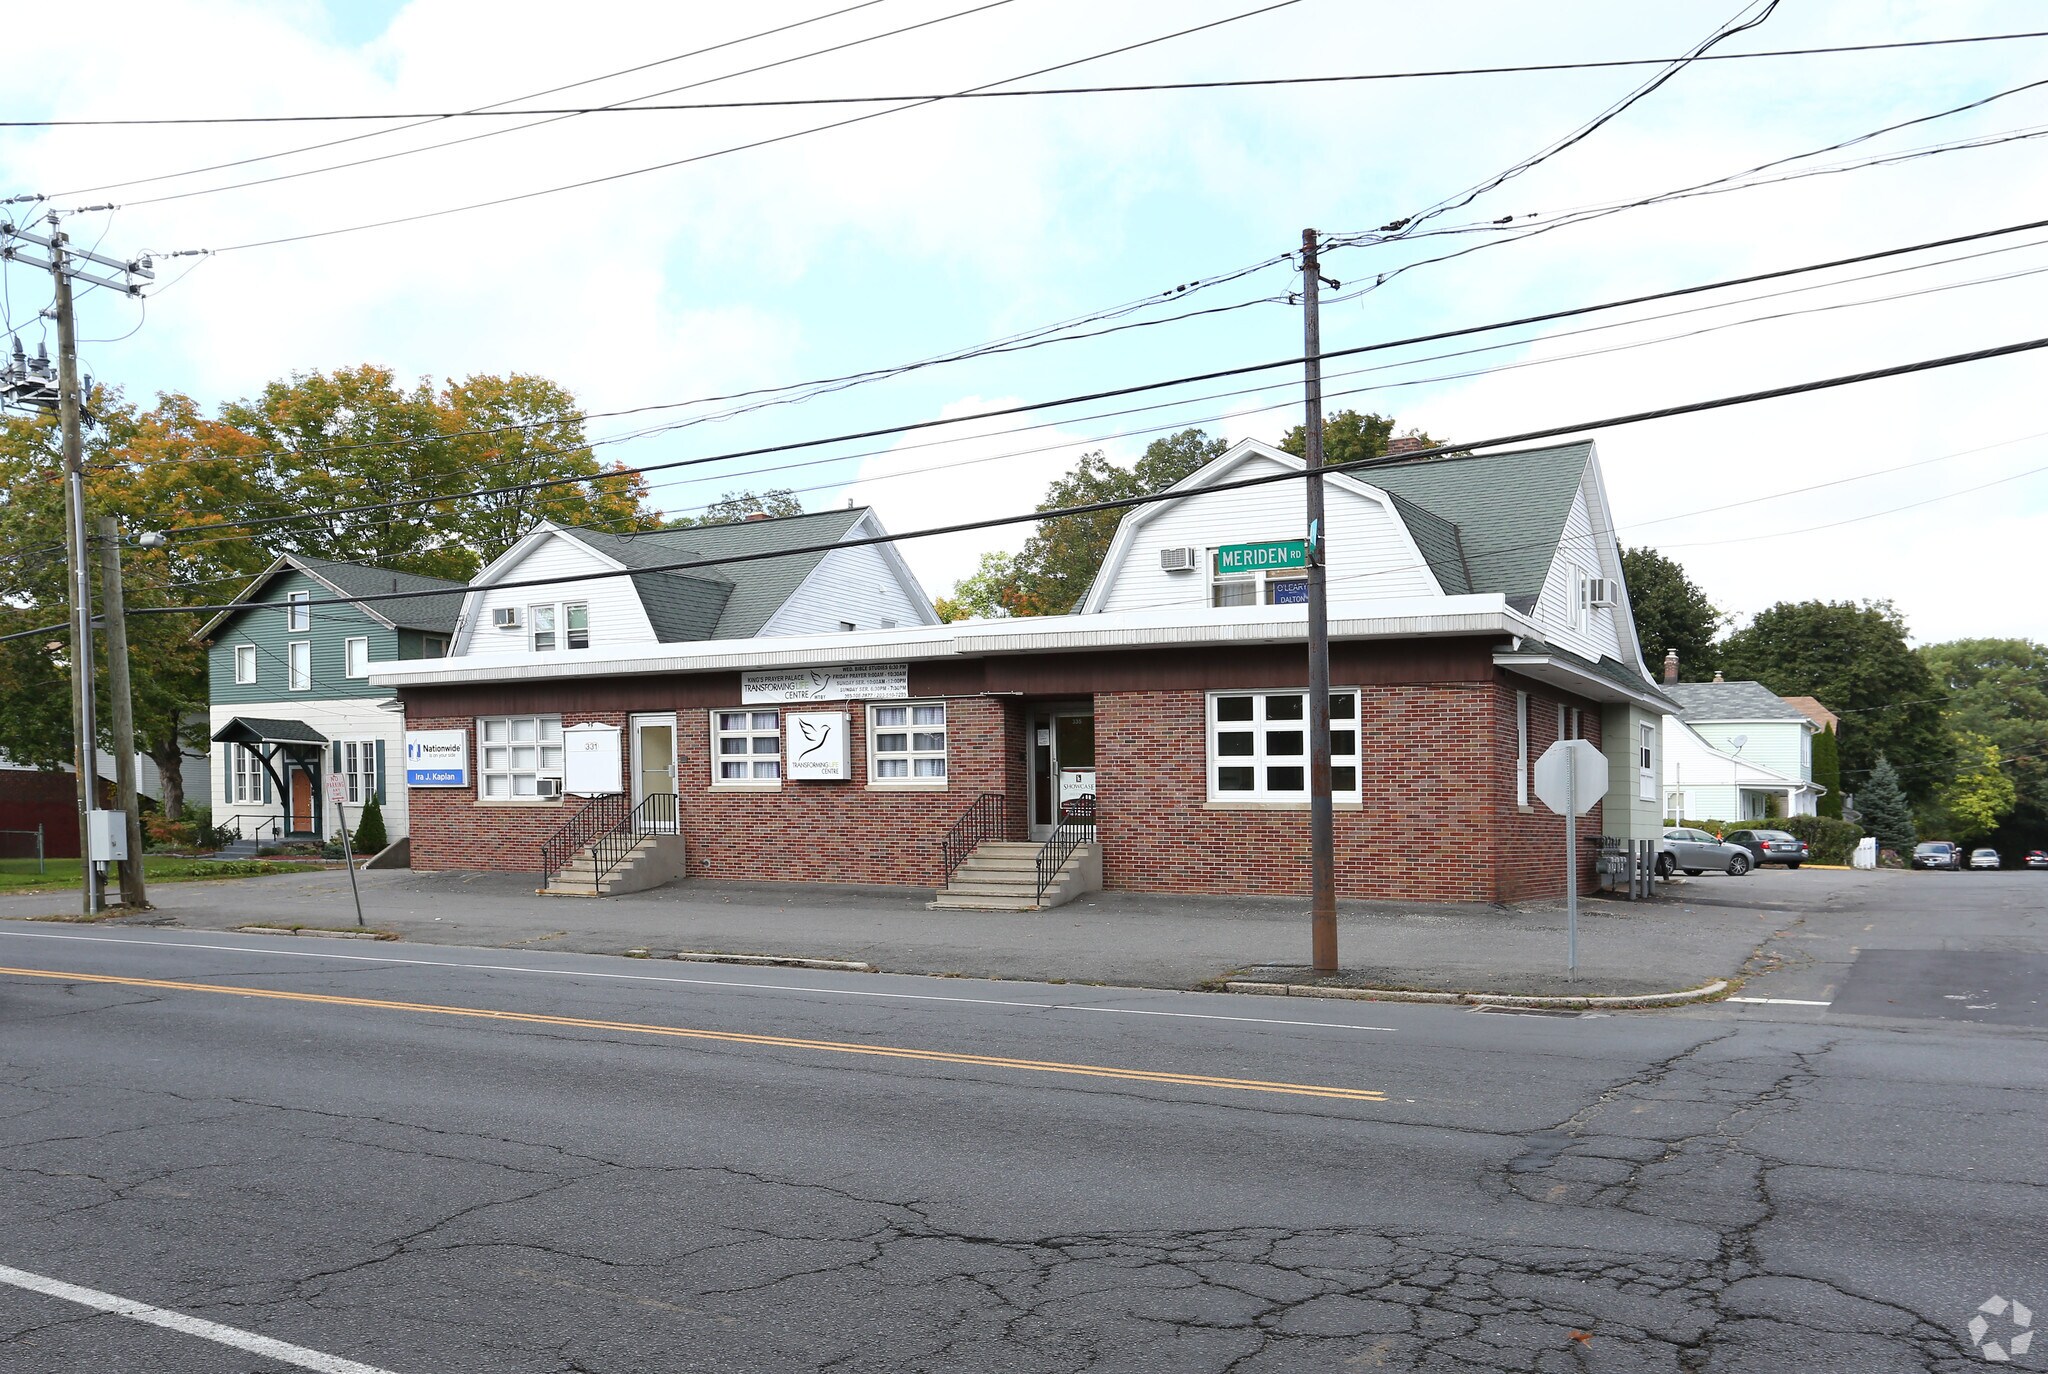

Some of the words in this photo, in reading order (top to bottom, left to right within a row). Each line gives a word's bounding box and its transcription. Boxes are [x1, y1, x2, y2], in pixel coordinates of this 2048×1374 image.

[1222, 547, 1288, 567] MERIDEN
[1290, 550, 1302, 559] RD
[1276, 583, 1308, 592] O'LEARY
[1280, 595, 1305, 603] DALTON
[744, 681, 795, 692] TRANSFORMING
[795, 680, 809, 690] LIFE
[784, 690, 809, 700] CENTRE
[423, 744, 461, 753] Nationwide
[584, 742, 598, 751] 331
[415, 772, 424, 781] Ira
[425, 772, 431, 781] J.
[432, 772, 455, 782] Kaplan
